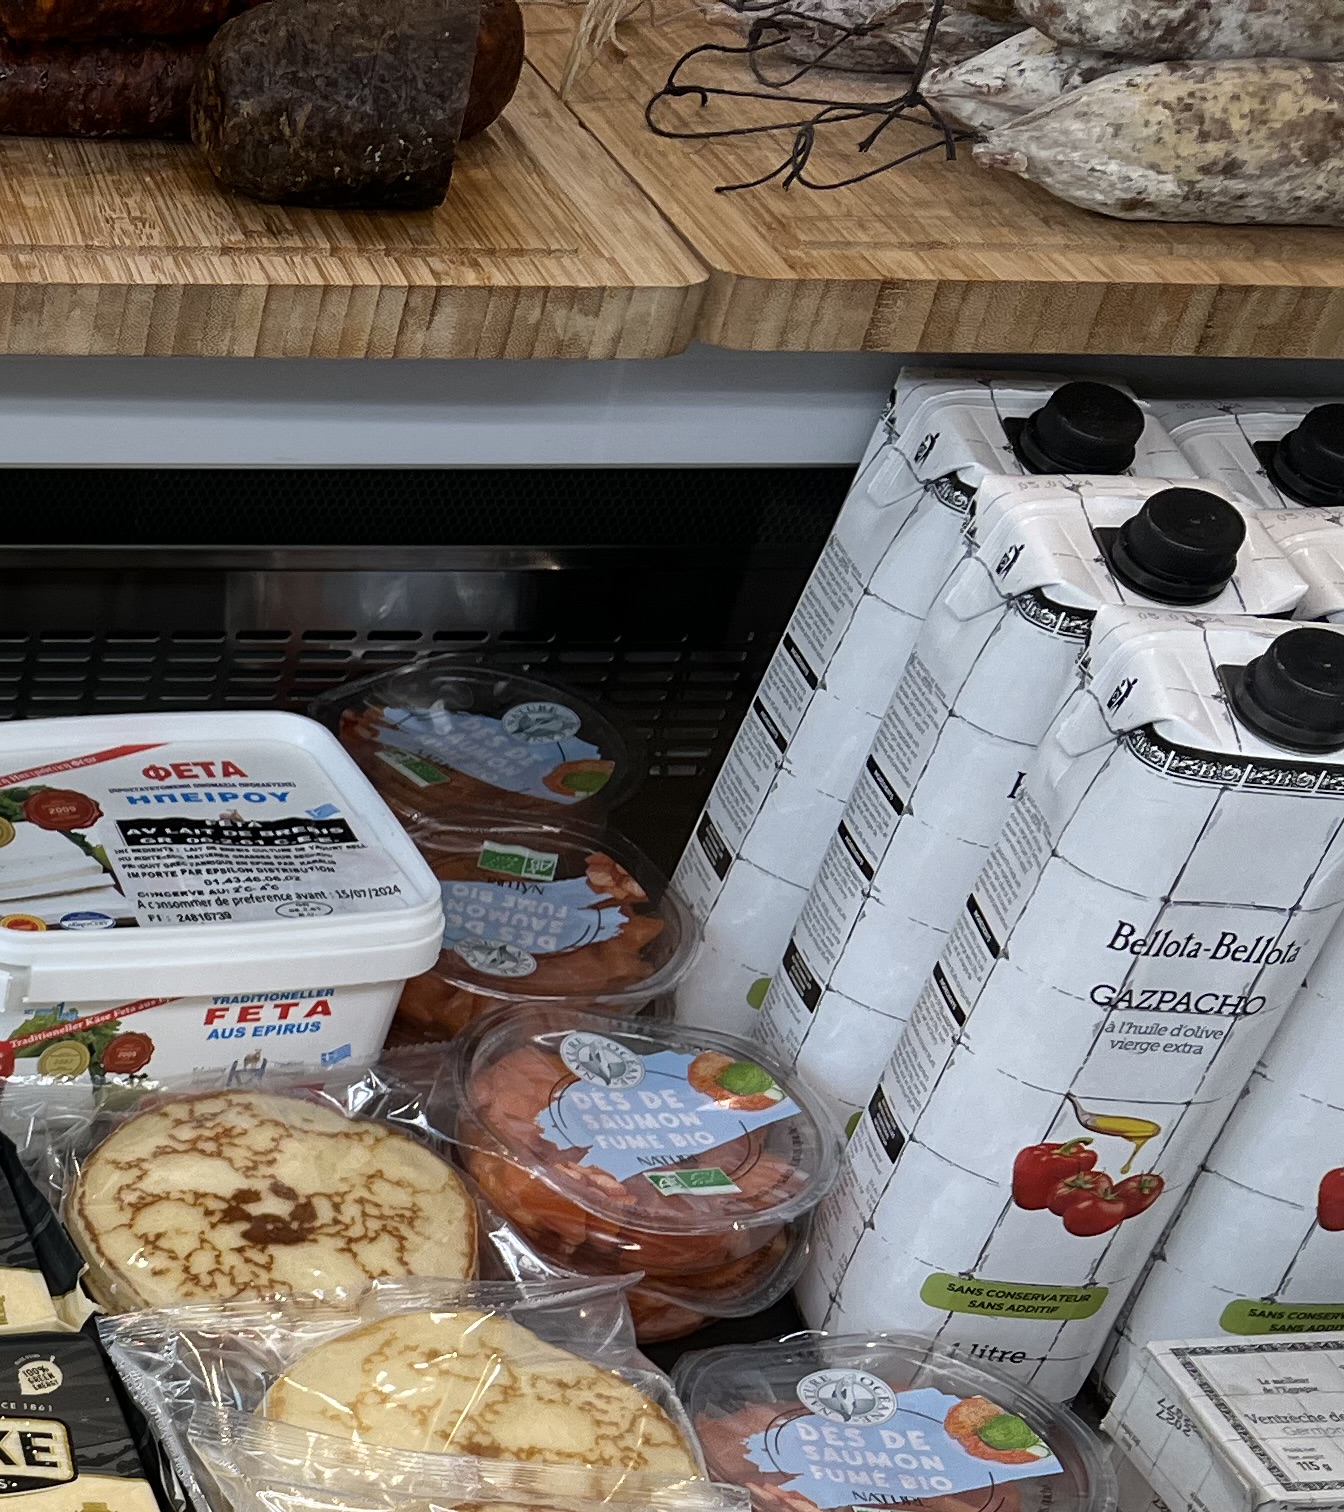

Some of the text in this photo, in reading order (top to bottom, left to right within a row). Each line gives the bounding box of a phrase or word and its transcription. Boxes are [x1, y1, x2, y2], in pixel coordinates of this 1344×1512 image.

[215, 895, 230, 906] de
[295, 891, 327, 901] avant
[334, 884, 402, 902] 15/07/2024
[1107, 920, 1302, 965] Bellota-Bellota
[212, 988, 336, 1006] TRADITIONELLER
[1089, 984, 1267, 1017] GAZPACHO
[203, 999, 333, 1026] FETA
[9, 1019, 85, 1049] Traditioneller
[112, 1004, 137, 1020] Feta
[206, 1021, 322, 1041] AUS EPIRUS
[1170, 1022, 1224, 1041] d'olive
[1110, 1039, 1204, 1056] vierge extra
[570, 1087, 685, 1112] DÉS DE
[582, 1112, 704, 1132] SAUMON
[668, 1131, 716, 1149] BIO
[946, 1282, 1092, 1304] SANS CONSERVATEUR
[967, 1299, 1061, 1315] SANS ADDITIF
[1247, 1308, 1286, 1320] SANS
[1269, 1323, 1305, 1333] SANS
[969, 1342, 1027, 1365] litre
[22, 1402, 54, 1413] 1861
[795, 1421, 932, 1452] DÉS DE
[801, 1444, 946, 1473] SAUMON
[1297, 1460, 1321, 1472] 115
[900, 1474, 953, 1492] BIO
